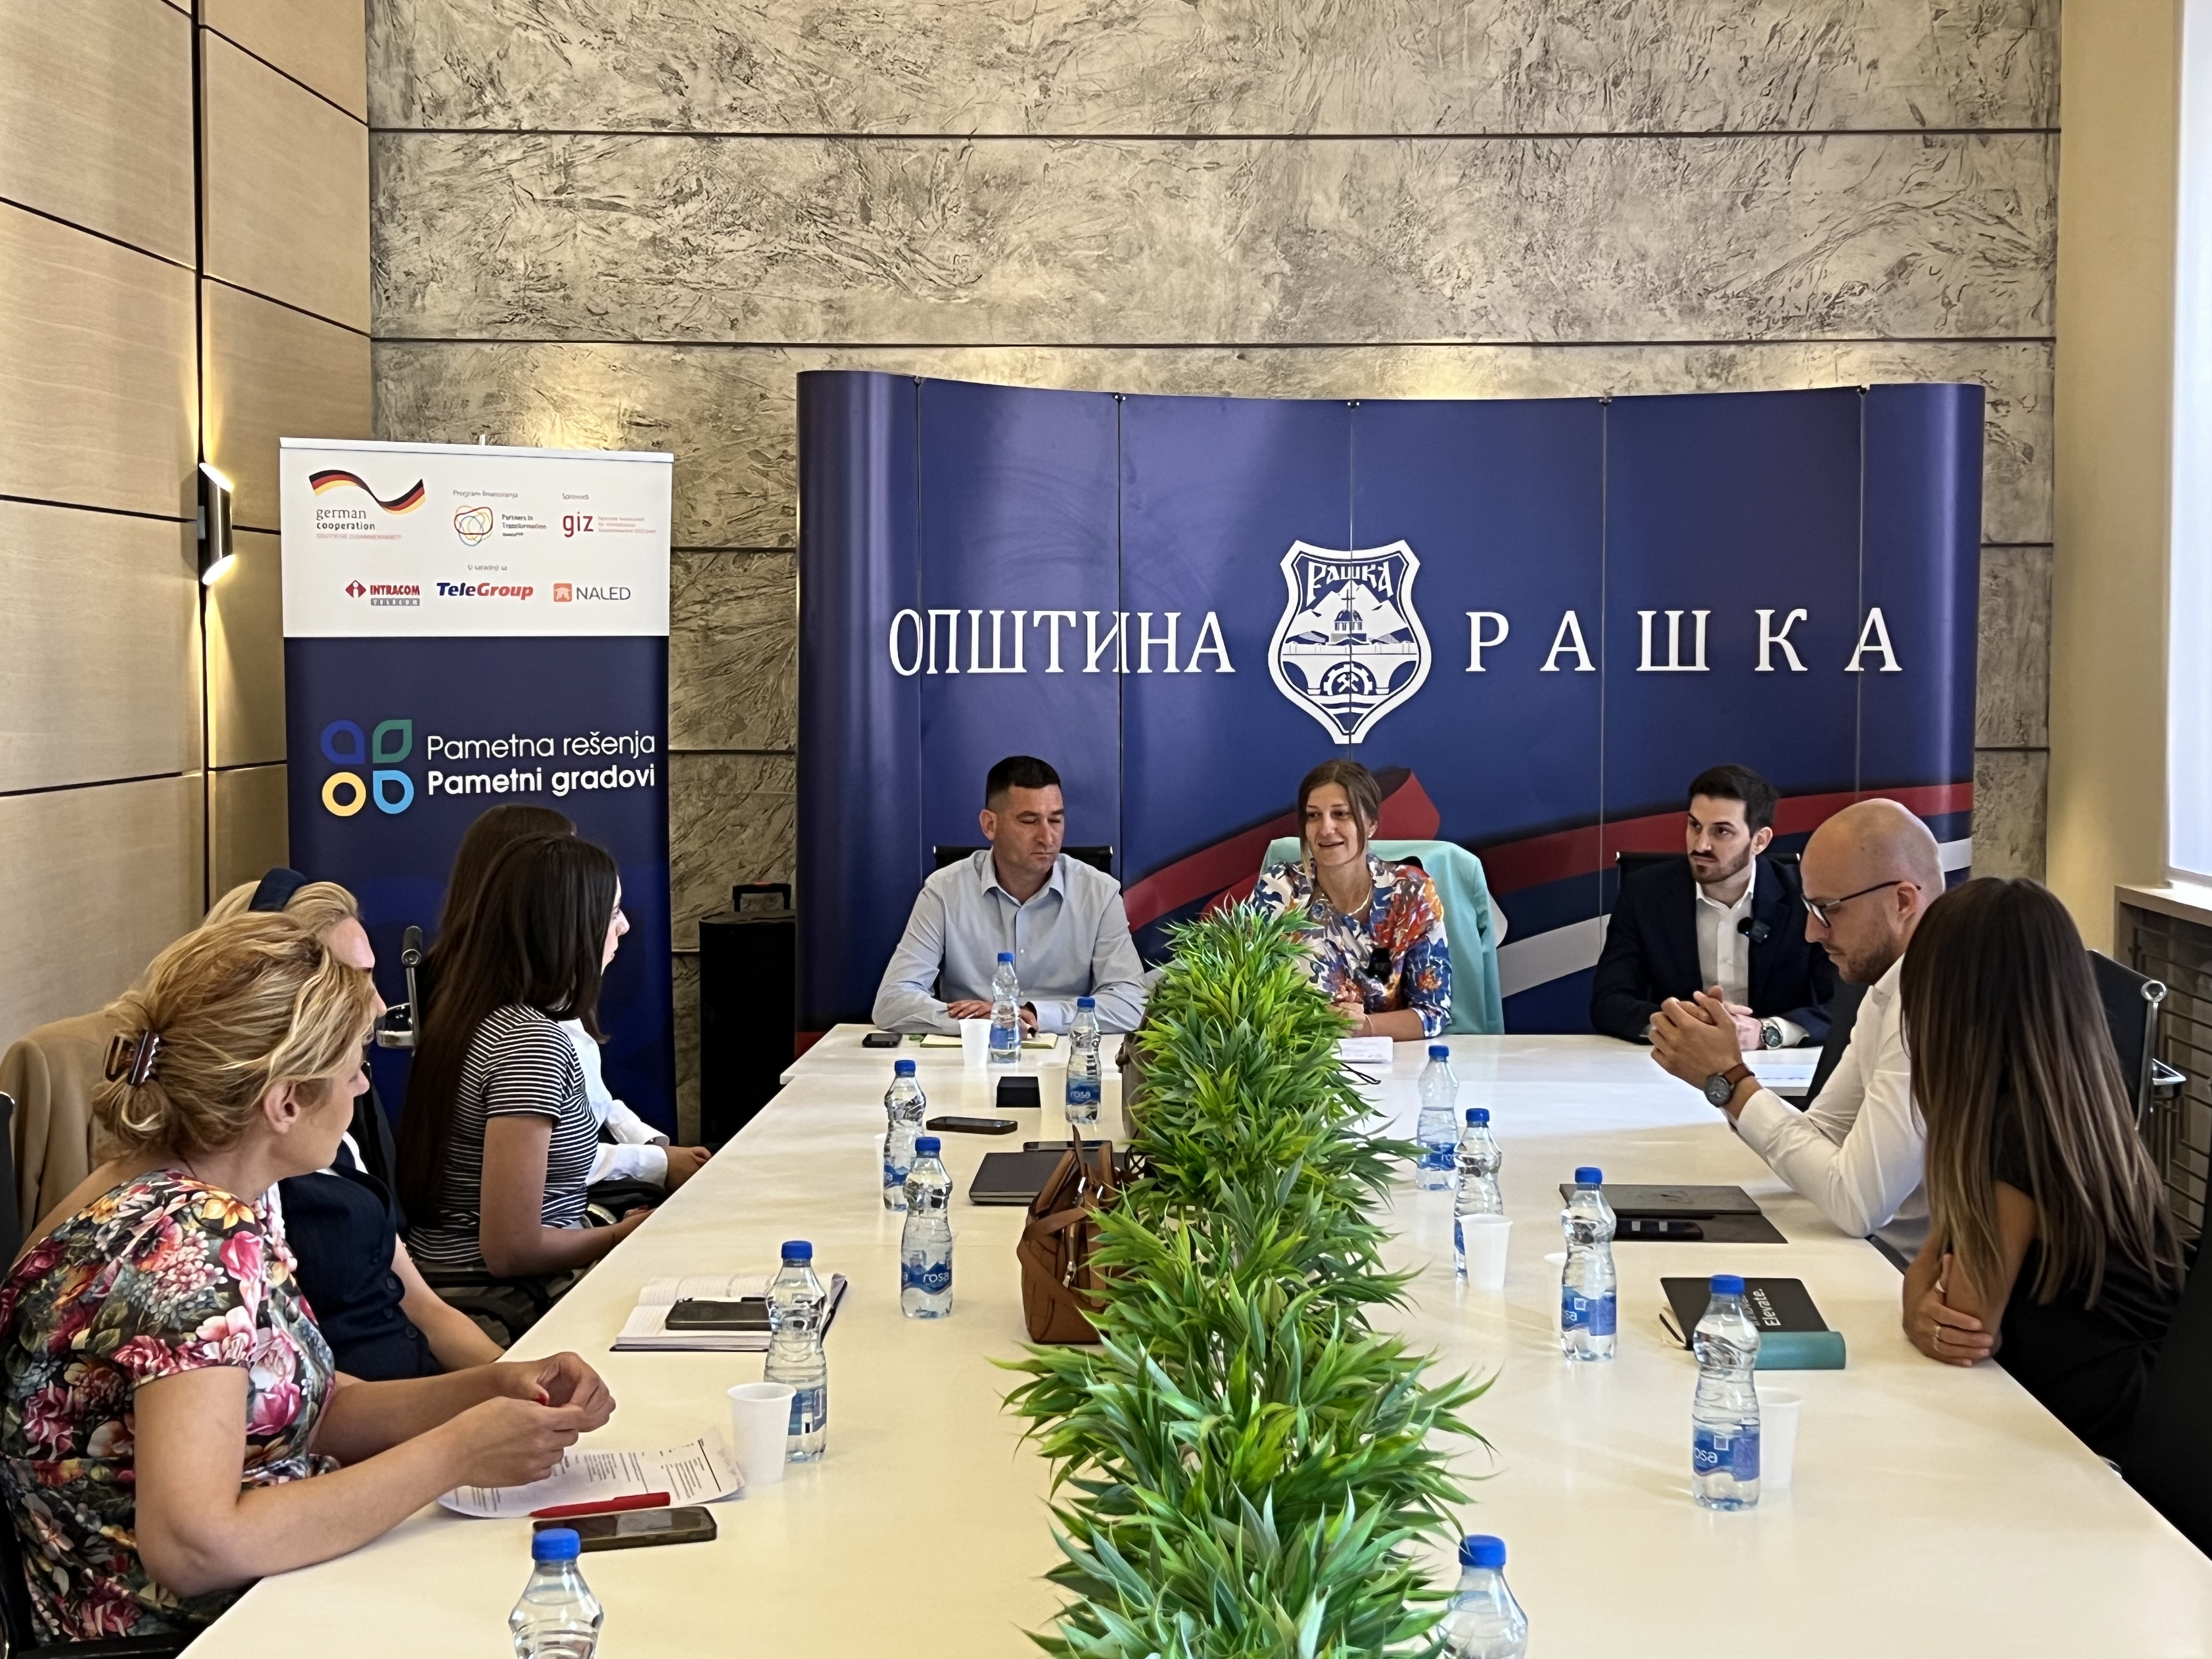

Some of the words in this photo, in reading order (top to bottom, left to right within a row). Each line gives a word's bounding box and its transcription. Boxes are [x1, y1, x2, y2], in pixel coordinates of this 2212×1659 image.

[316, 509, 366, 521] german
[317, 522, 375, 531] cooperation
[562, 511, 594, 538] giz
[370, 585, 420, 596] INTRACOM
[437, 582, 534, 600] TeleGroup
[576, 586, 631, 600] NALED
[889, 608, 1235, 676] ОПШТИНА
[427, 733, 554, 760] Pametna
[563, 730, 655, 759] rešenja
[428, 767, 542, 795] Pametni
[551, 763, 655, 797] gradovi
[923, 1272, 950, 1283] rosa
[1753, 1288, 1781, 1326] Elevate.
[1694, 1447, 1718, 1463] osa
